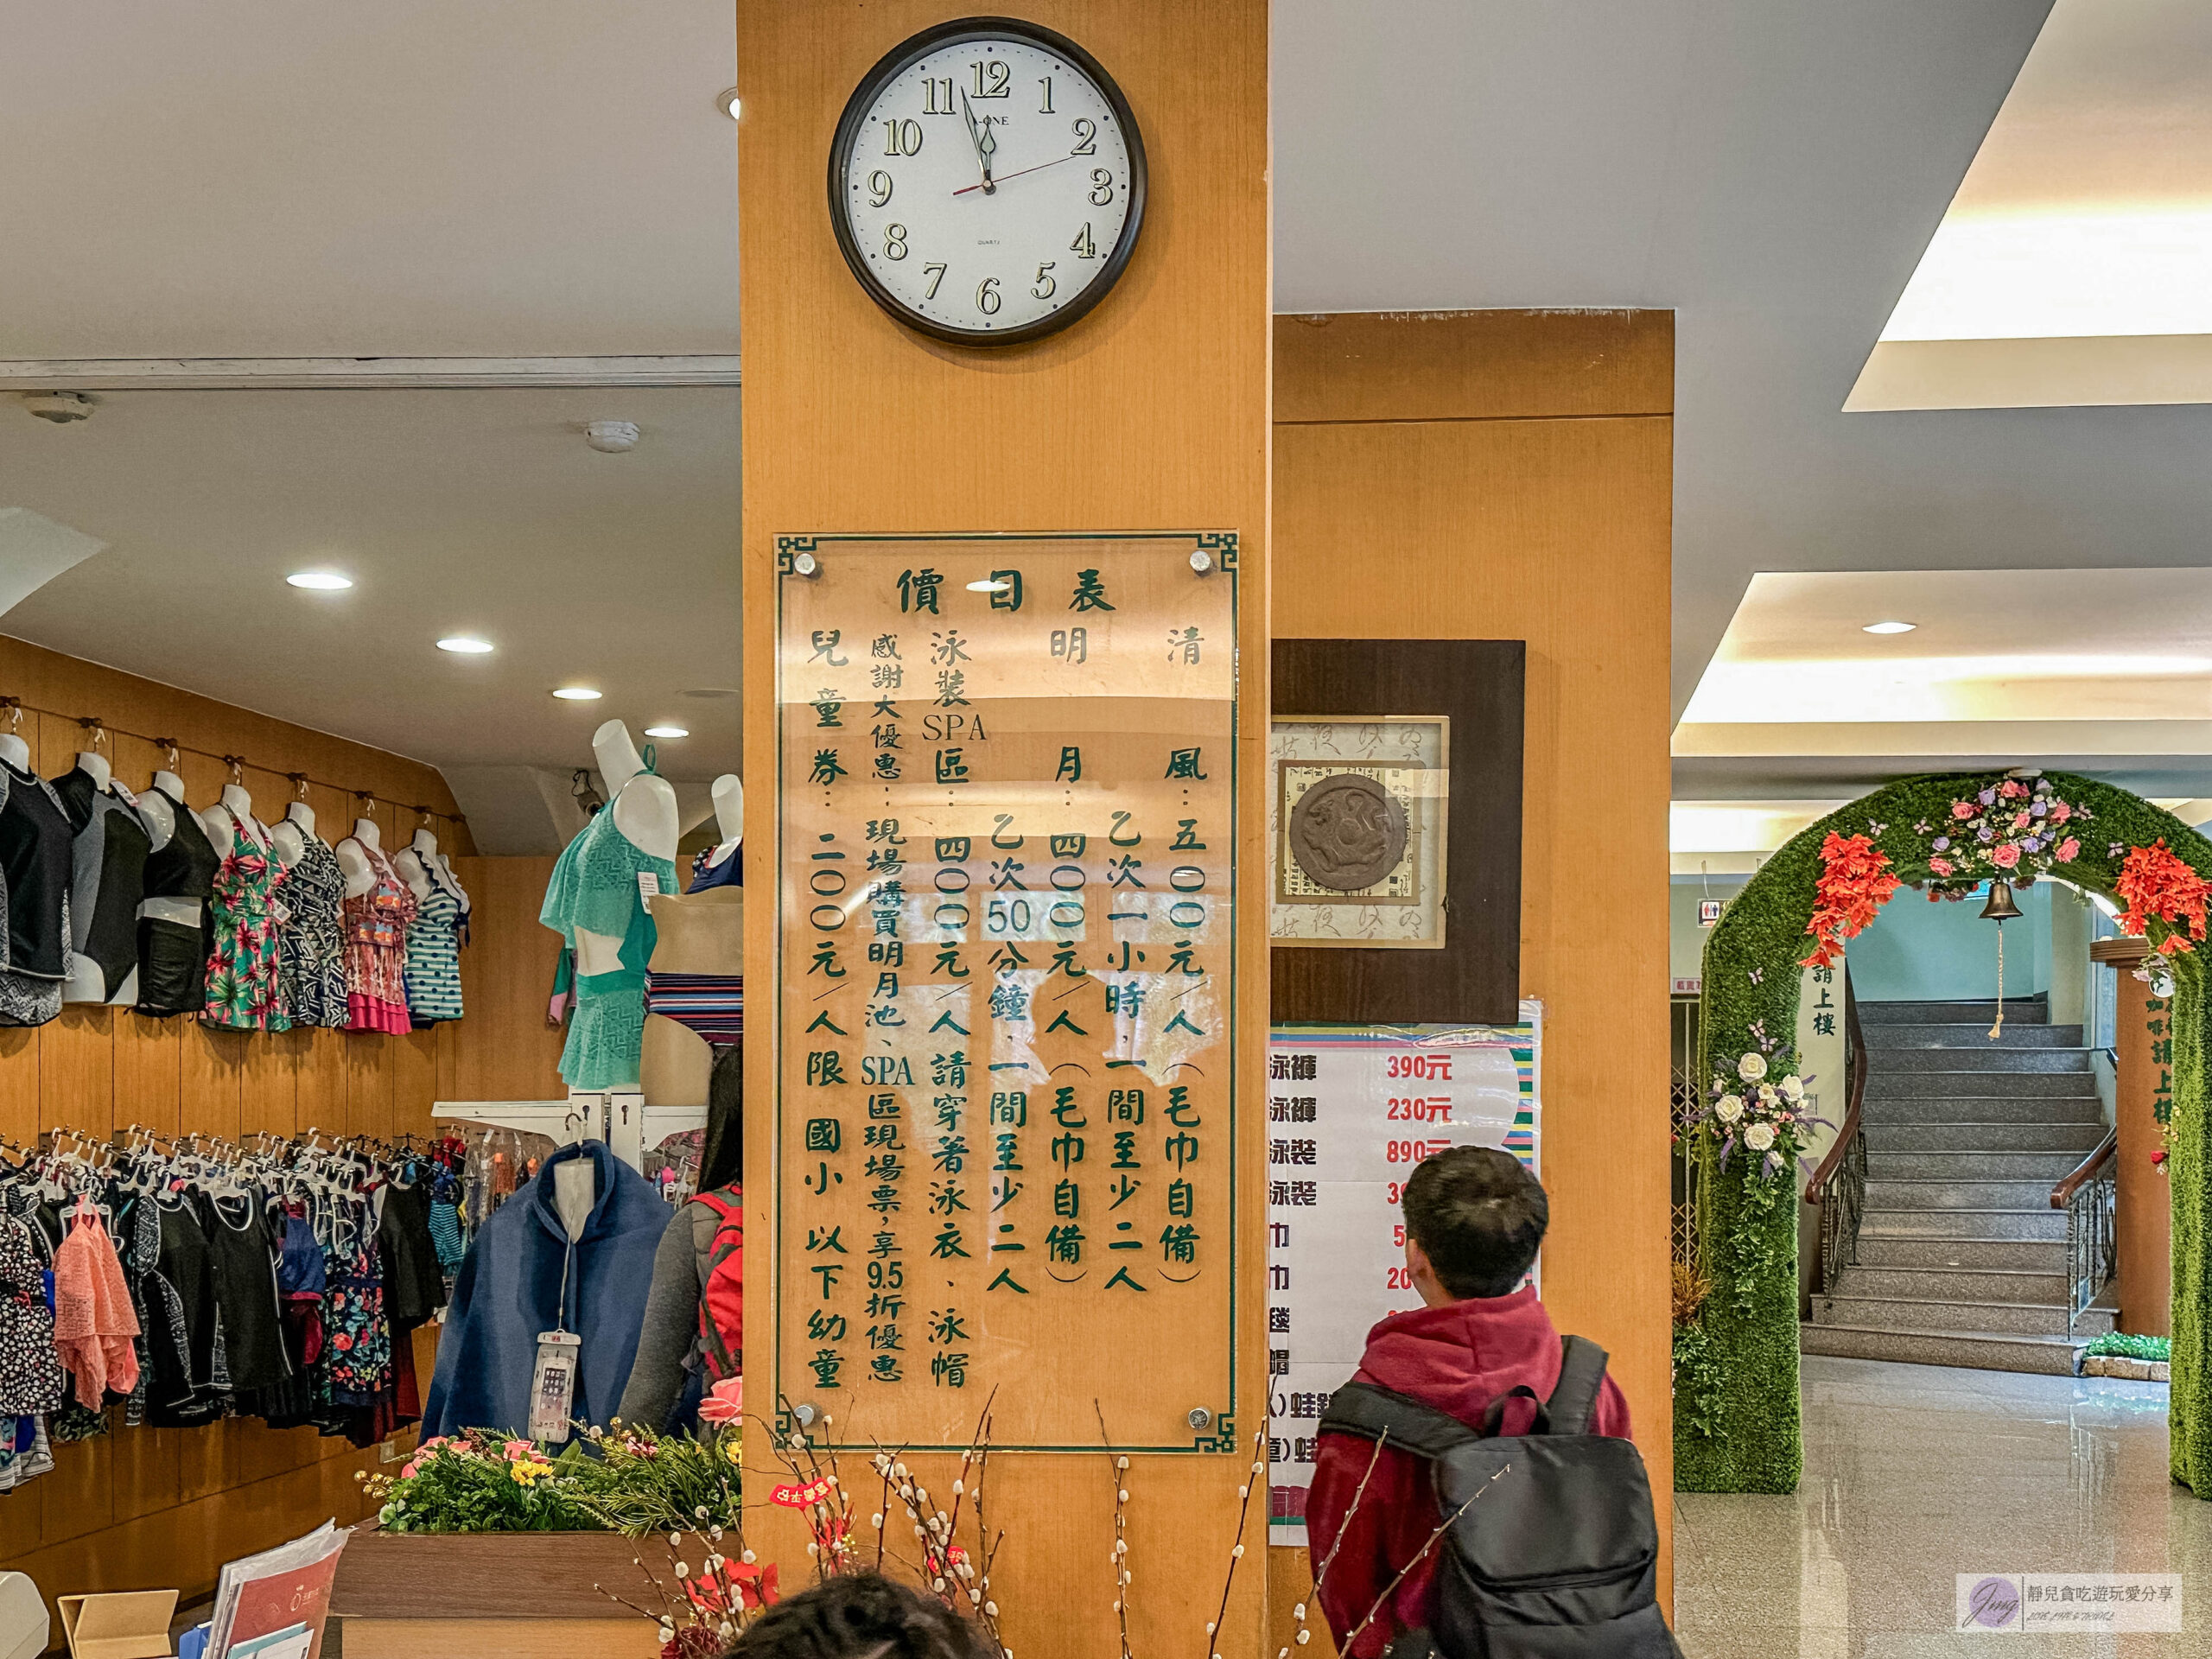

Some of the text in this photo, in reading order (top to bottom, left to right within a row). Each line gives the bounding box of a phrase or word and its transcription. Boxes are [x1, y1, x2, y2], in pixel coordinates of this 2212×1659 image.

[921, 78, 957, 115] 11
[969, 60, 1010, 99] 12
[1039, 76, 1056, 114] 1
[883, 119, 923, 156] 10
[1071, 118, 1096, 156] 2
[868, 170, 893, 207] 9
[1088, 168, 1113, 206] 3
[883, 223, 908, 260] 8
[1070, 221, 1096, 259] 4
[923, 262, 947, 299] 7
[976, 277, 1001, 315] 6
[1030, 261, 1056, 299] 5
[1387, 1054, 1452, 1080] 390元
[1387, 1096, 1452, 1122] 230元
